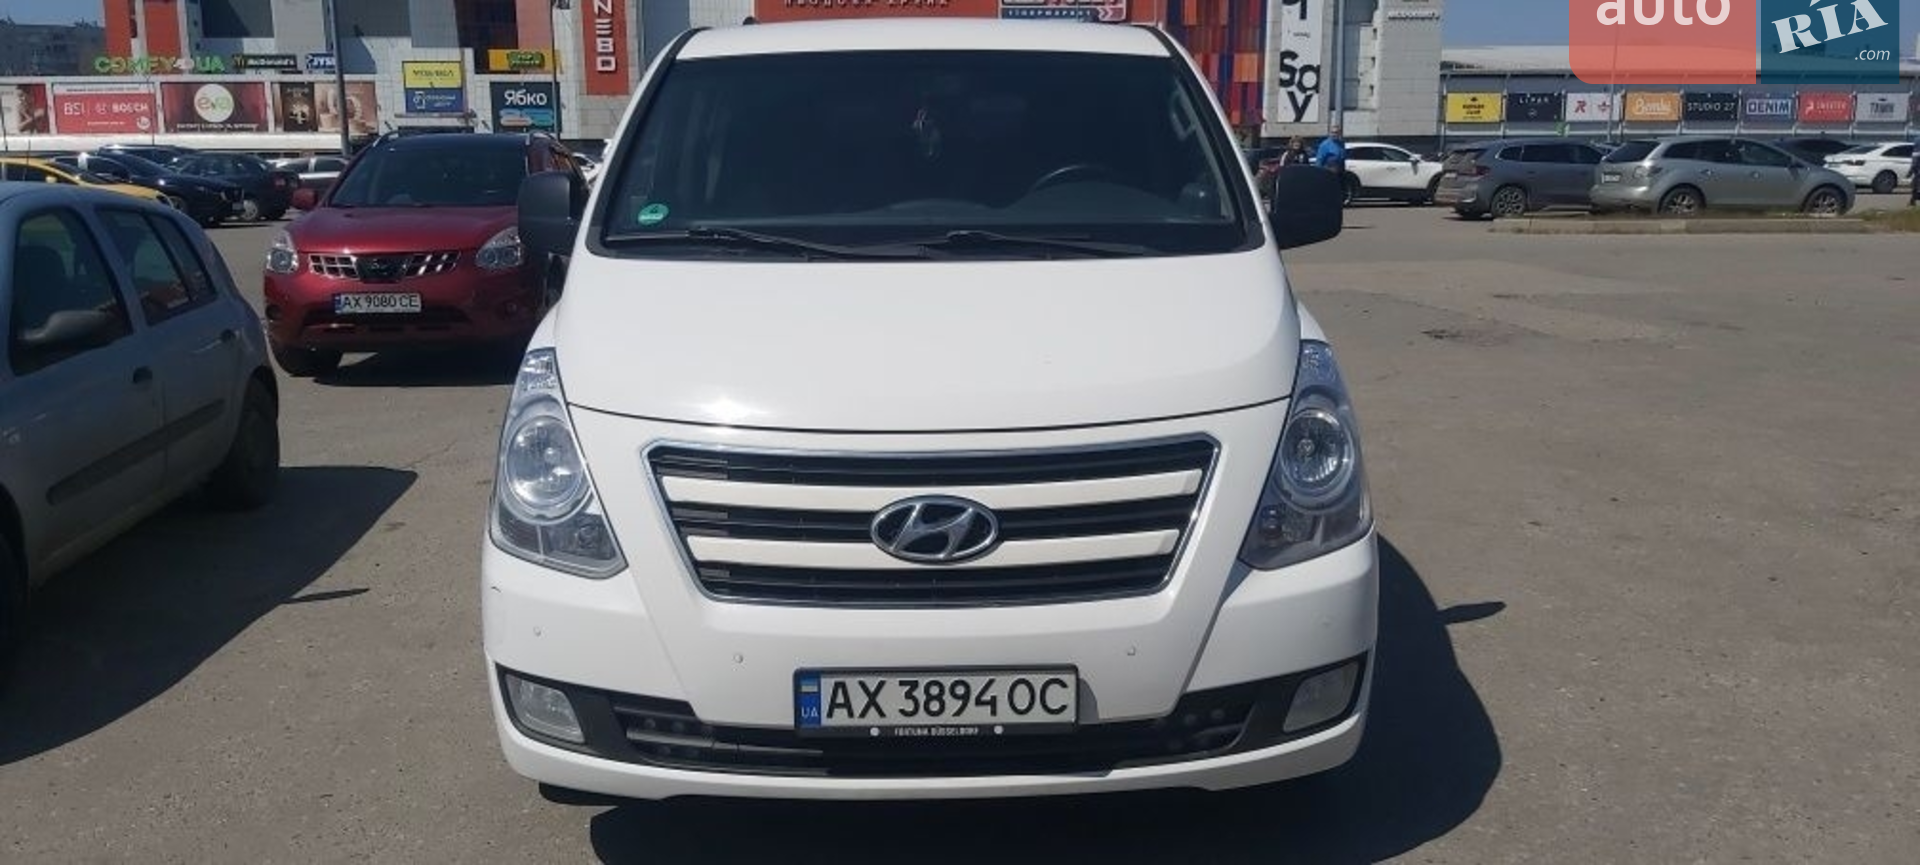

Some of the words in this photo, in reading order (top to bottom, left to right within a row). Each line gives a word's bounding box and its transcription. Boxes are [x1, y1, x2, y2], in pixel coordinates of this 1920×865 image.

[504, 89, 548, 106] Ябко
[1747, 100, 1791, 114] DENIM
[344, 296, 362, 309] AX
[400, 295, 420, 308] CE
[801, 708, 819, 718] UA
[826, 680, 887, 719] AX
[898, 678, 997, 718] 3894
[1007, 677, 1069, 716] OC
